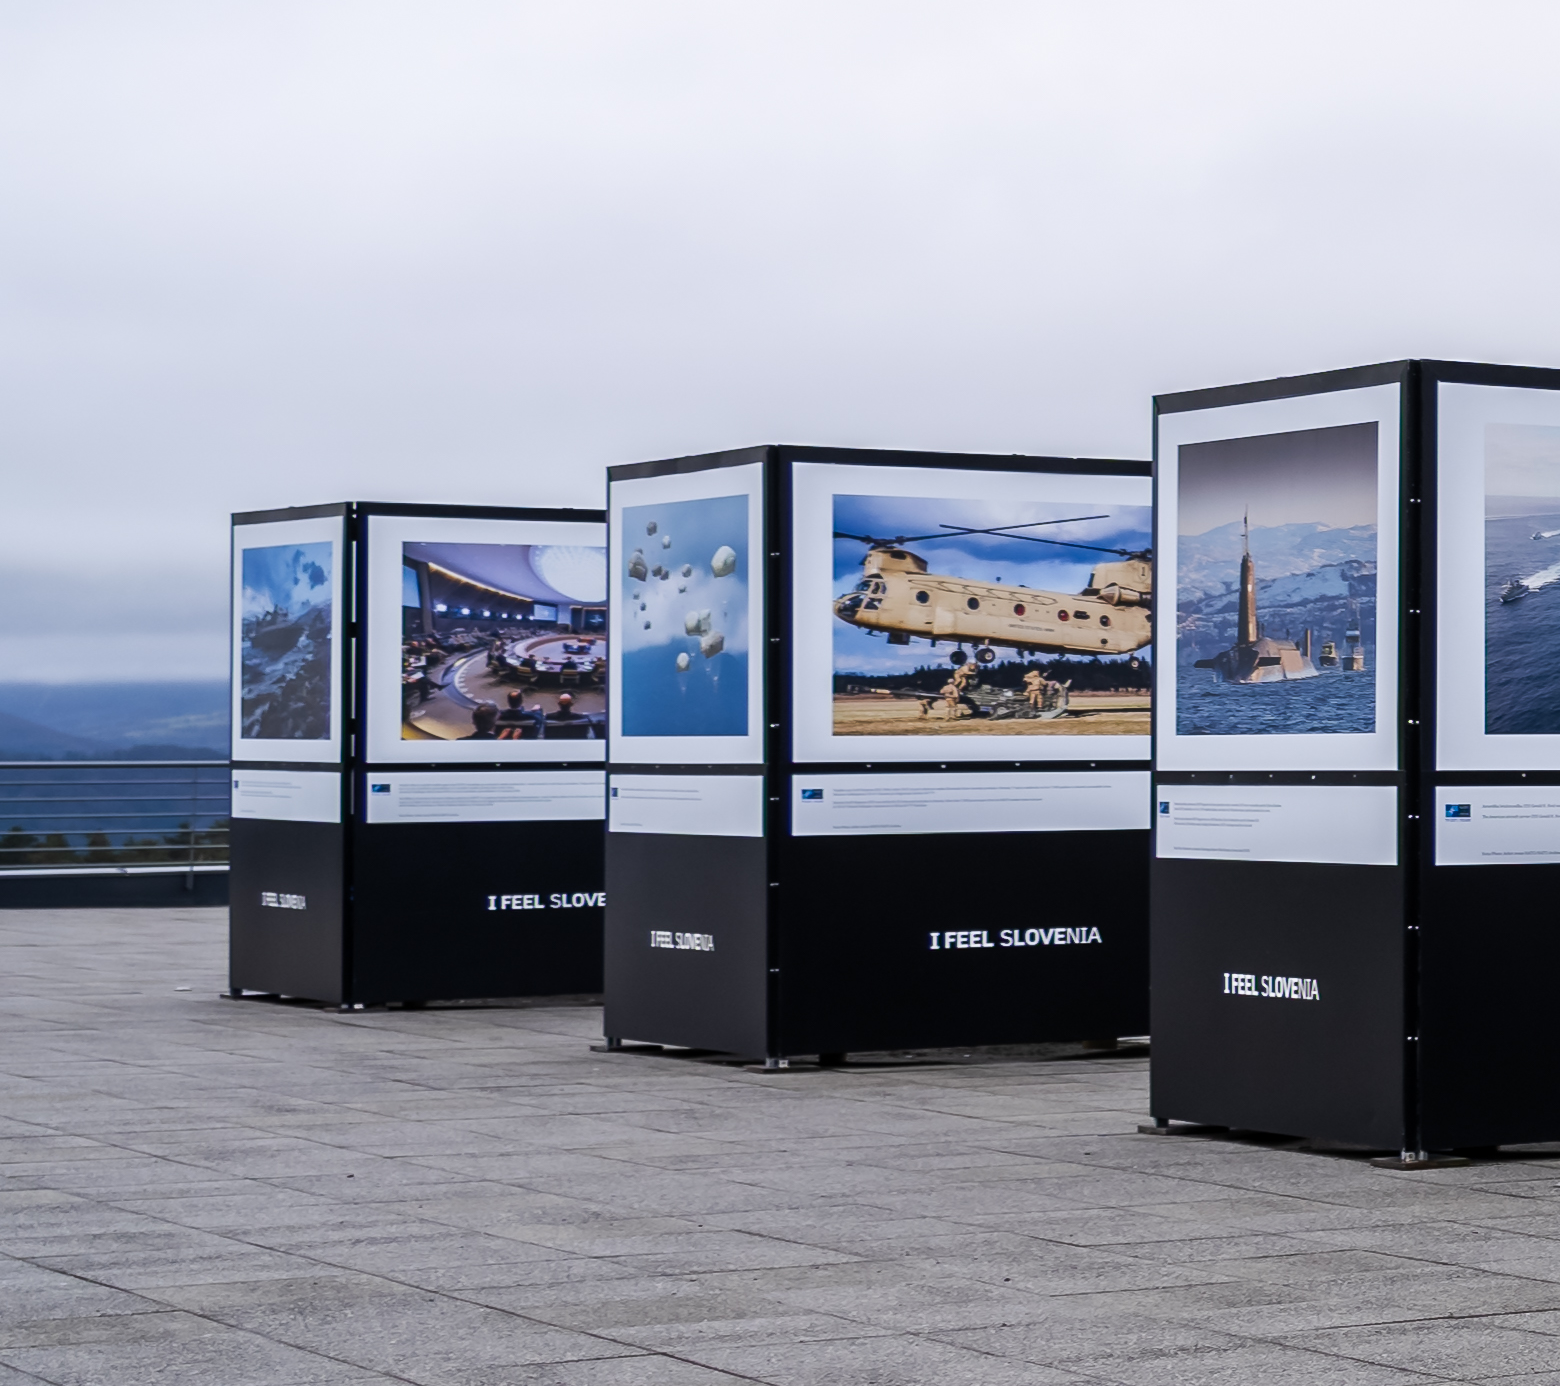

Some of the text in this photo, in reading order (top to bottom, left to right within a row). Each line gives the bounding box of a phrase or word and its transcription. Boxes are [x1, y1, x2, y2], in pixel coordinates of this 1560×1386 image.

[488, 896, 496, 910] I
[501, 895, 545, 909] FEEL
[930, 926, 1102, 949] I FEEL SLOVENIA
[1224, 972, 1320, 1000] I FEEL SLOVENIA
